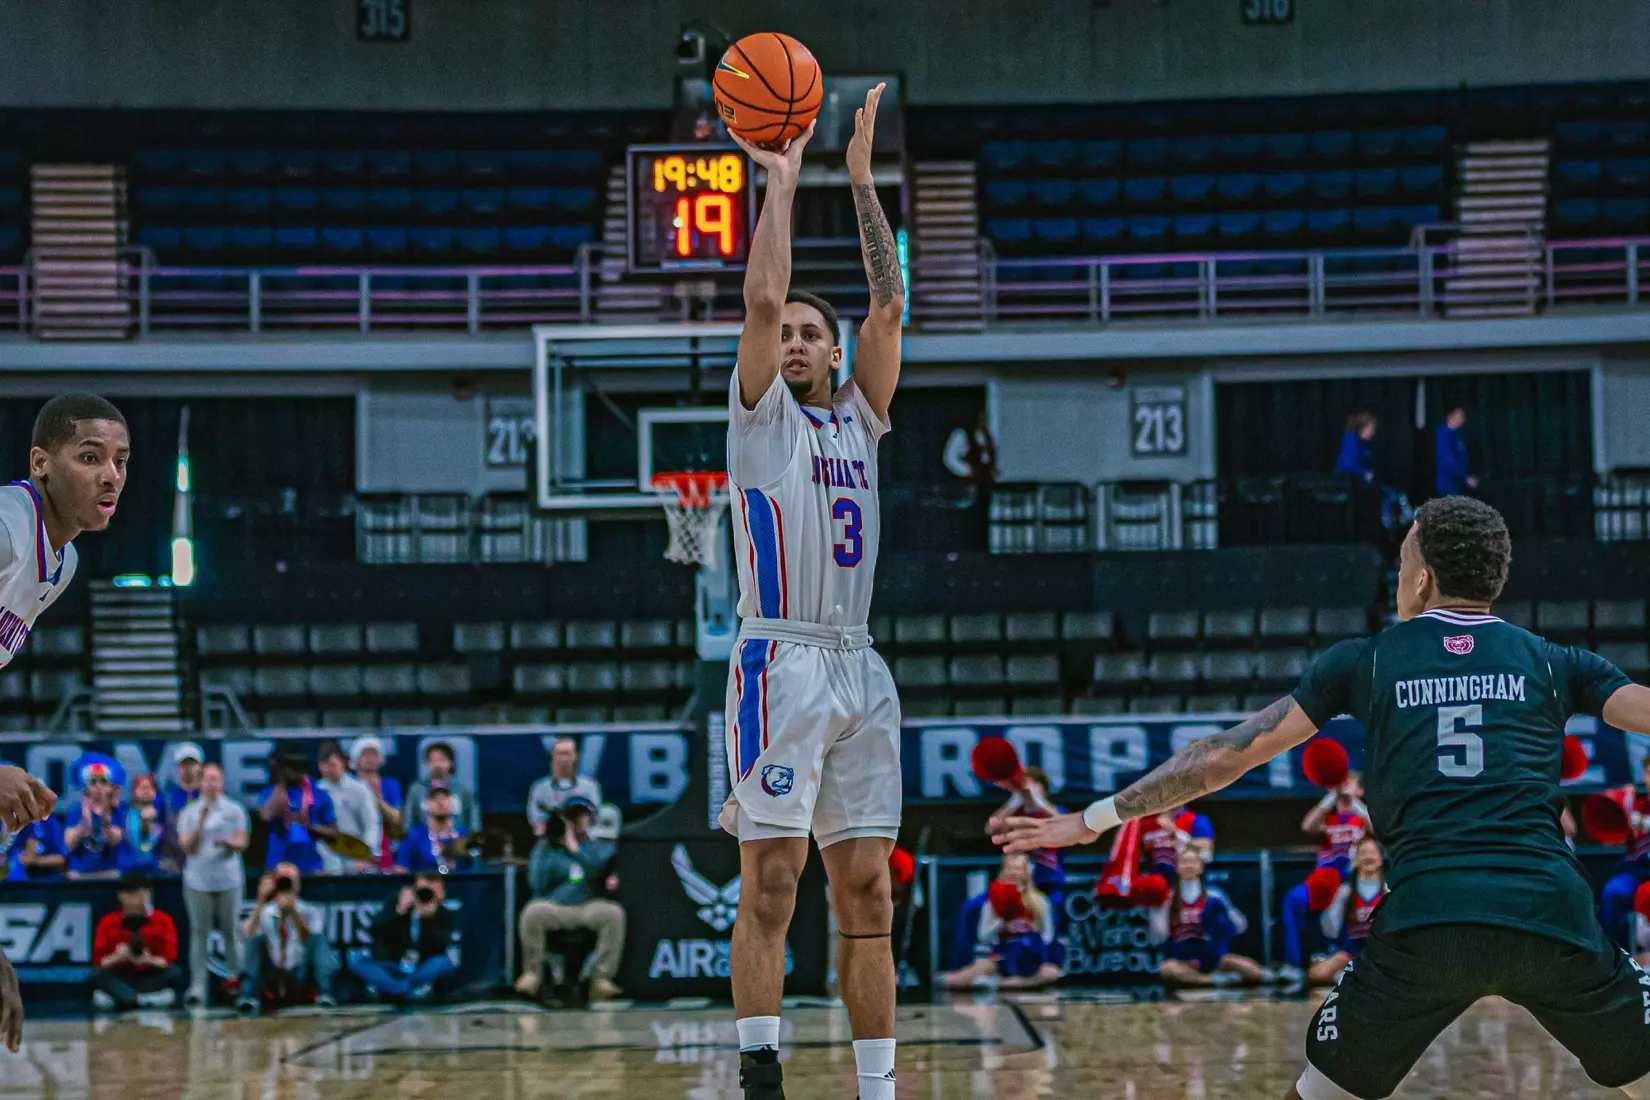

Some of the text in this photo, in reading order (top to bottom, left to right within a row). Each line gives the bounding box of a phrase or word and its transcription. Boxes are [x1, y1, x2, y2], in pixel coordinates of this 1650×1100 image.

[653, 155, 743, 193] 19:48
[675, 194, 735, 256] 19
[1135, 405, 1184, 452] 213
[832, 497, 863, 568] 3
[1395, 673, 1526, 708] CUNNINGHAM
[1437, 704, 1484, 777] 5
